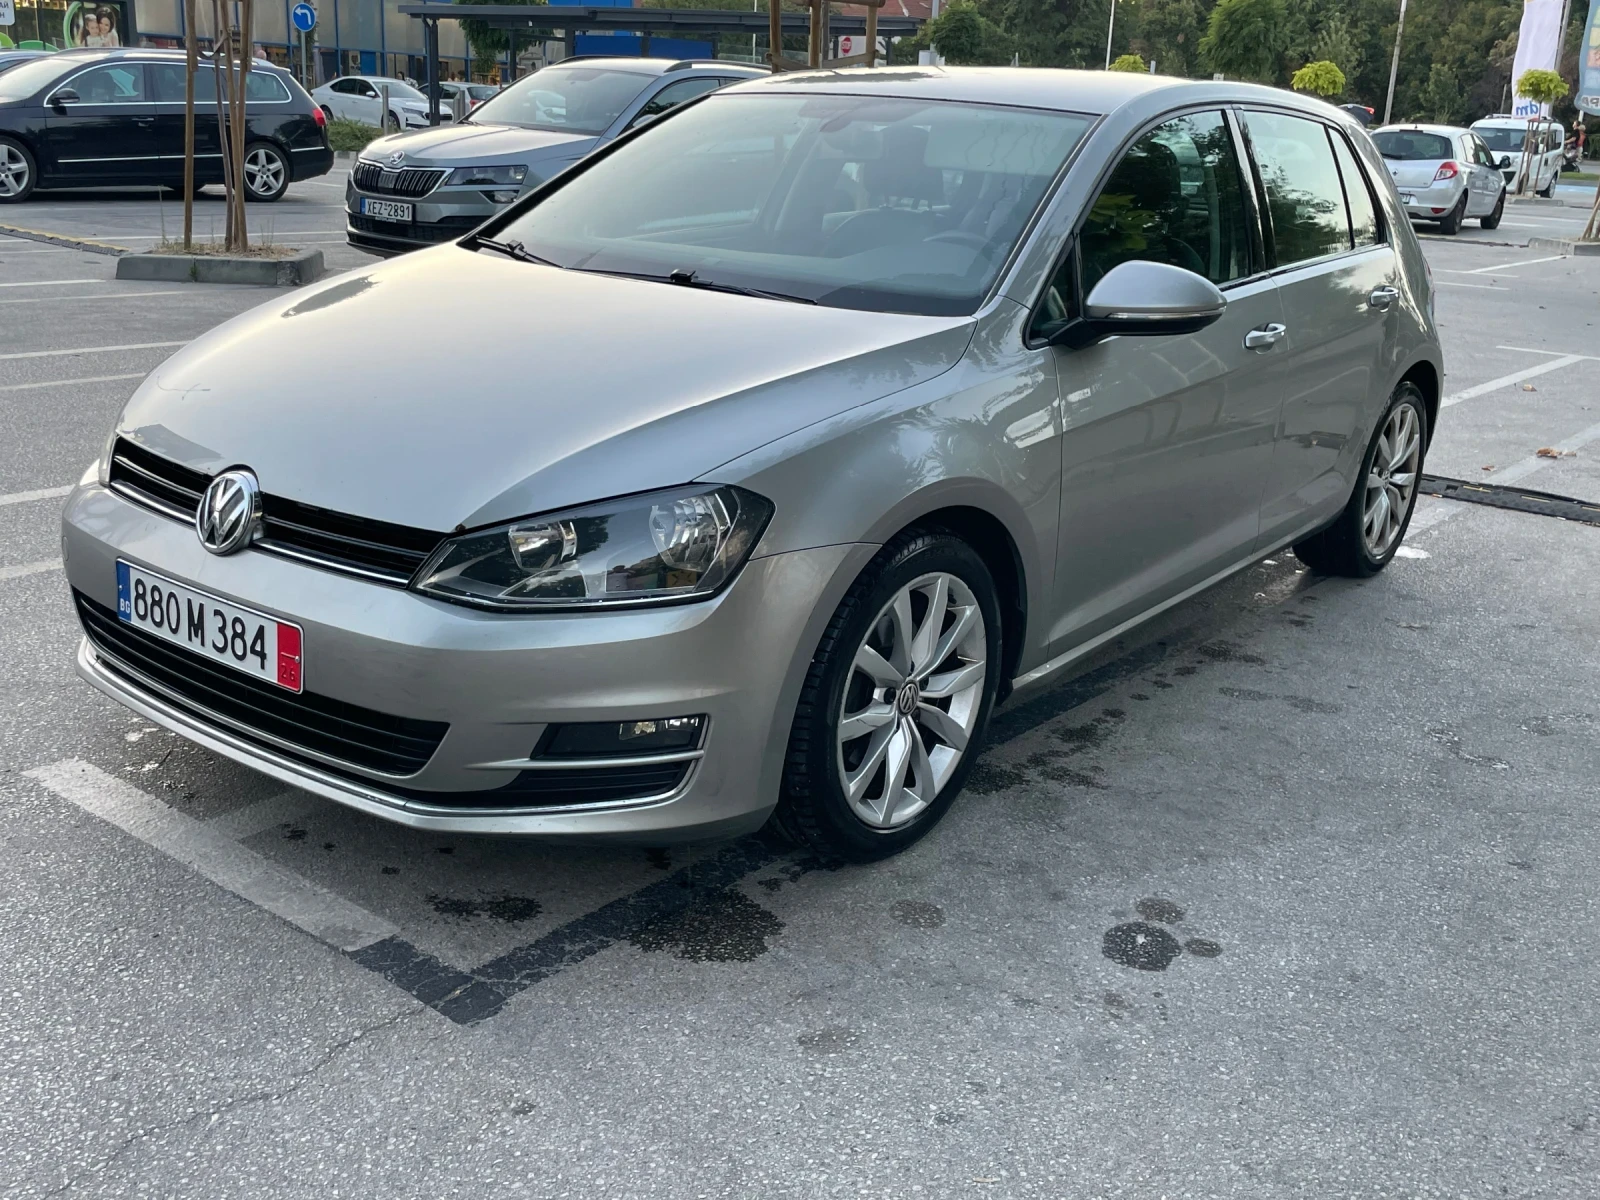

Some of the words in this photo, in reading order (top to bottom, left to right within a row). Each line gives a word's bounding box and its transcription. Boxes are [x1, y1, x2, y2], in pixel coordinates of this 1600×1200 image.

[120, 598, 131, 614] BG
[134, 578, 180, 634] 880
[187, 597, 205, 648] M
[212, 608, 267, 670] 384
[281, 662, 296, 682] 26
